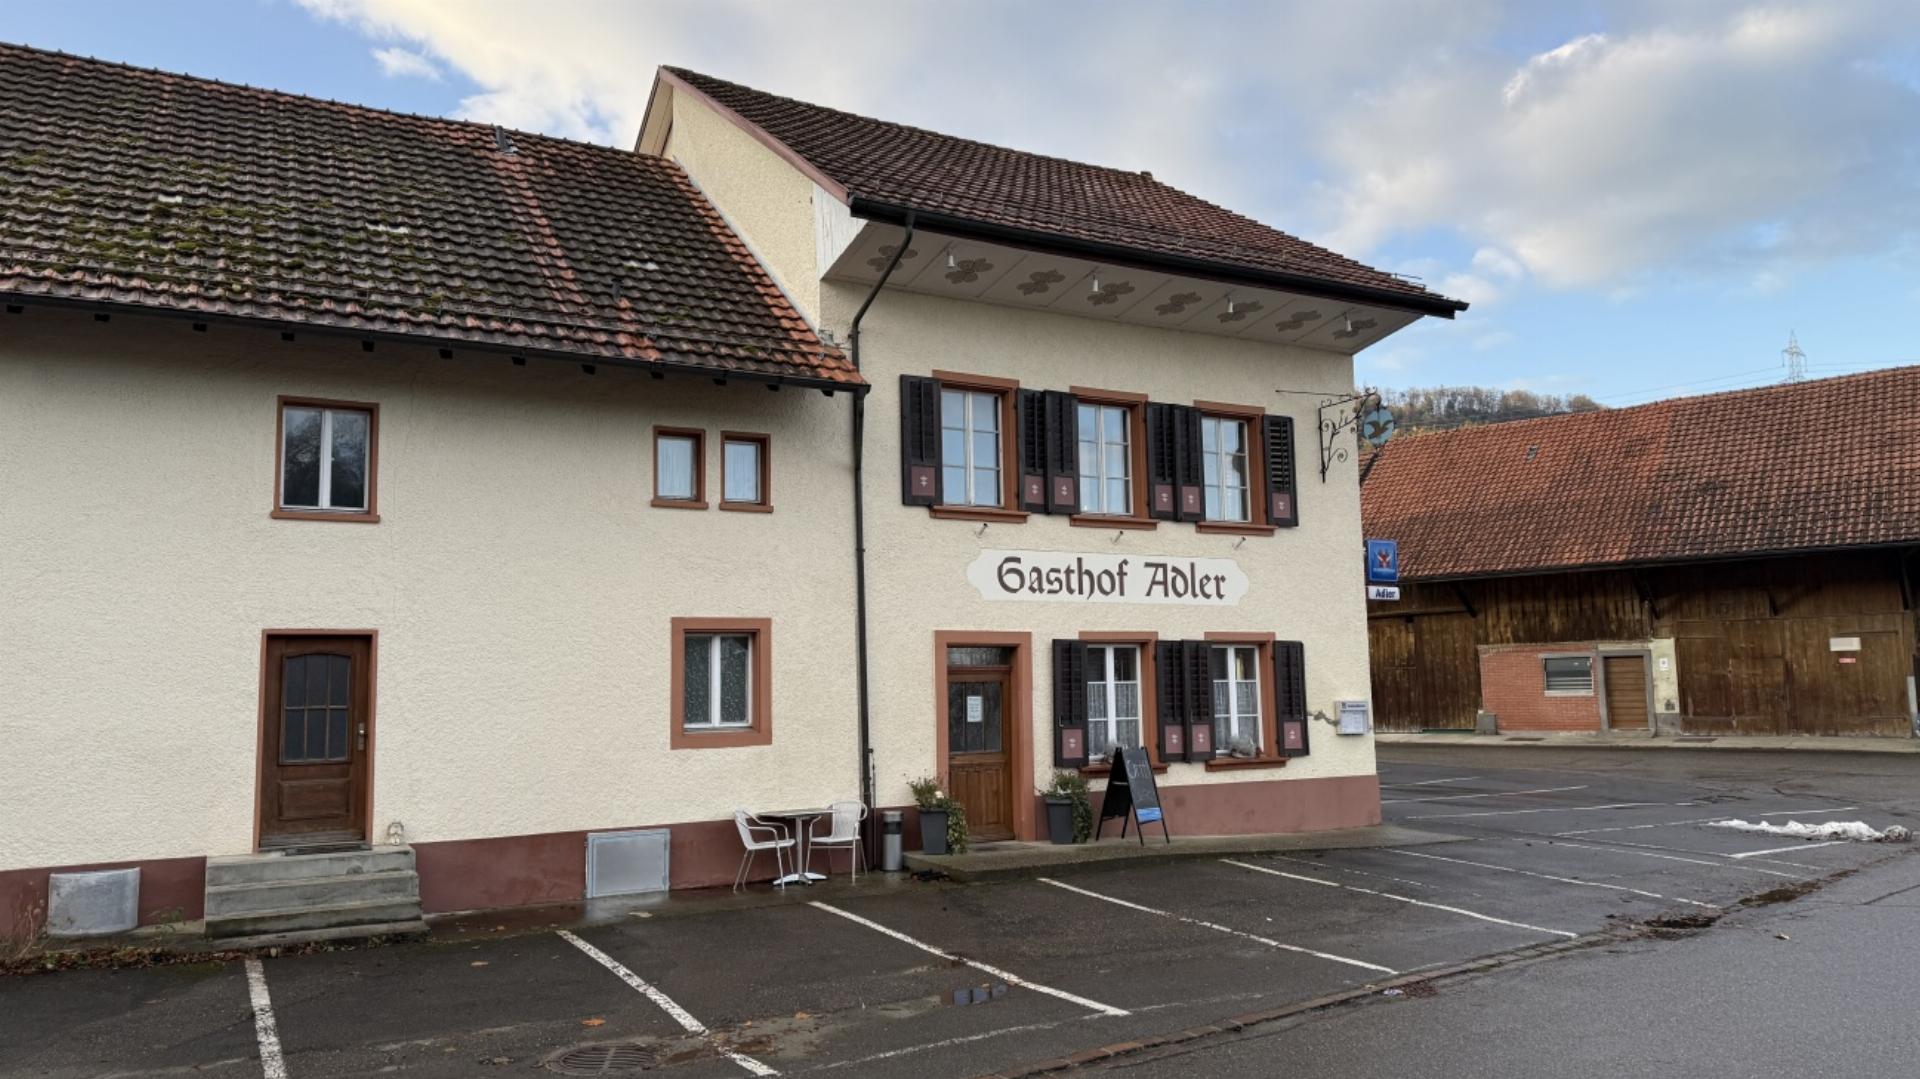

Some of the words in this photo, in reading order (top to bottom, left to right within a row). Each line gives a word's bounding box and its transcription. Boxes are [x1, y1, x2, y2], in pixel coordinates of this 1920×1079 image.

[997, 556, 1129, 599] Gasthof
[1144, 562, 1226, 599] Adler
[1375, 588, 1396, 599] Adler
